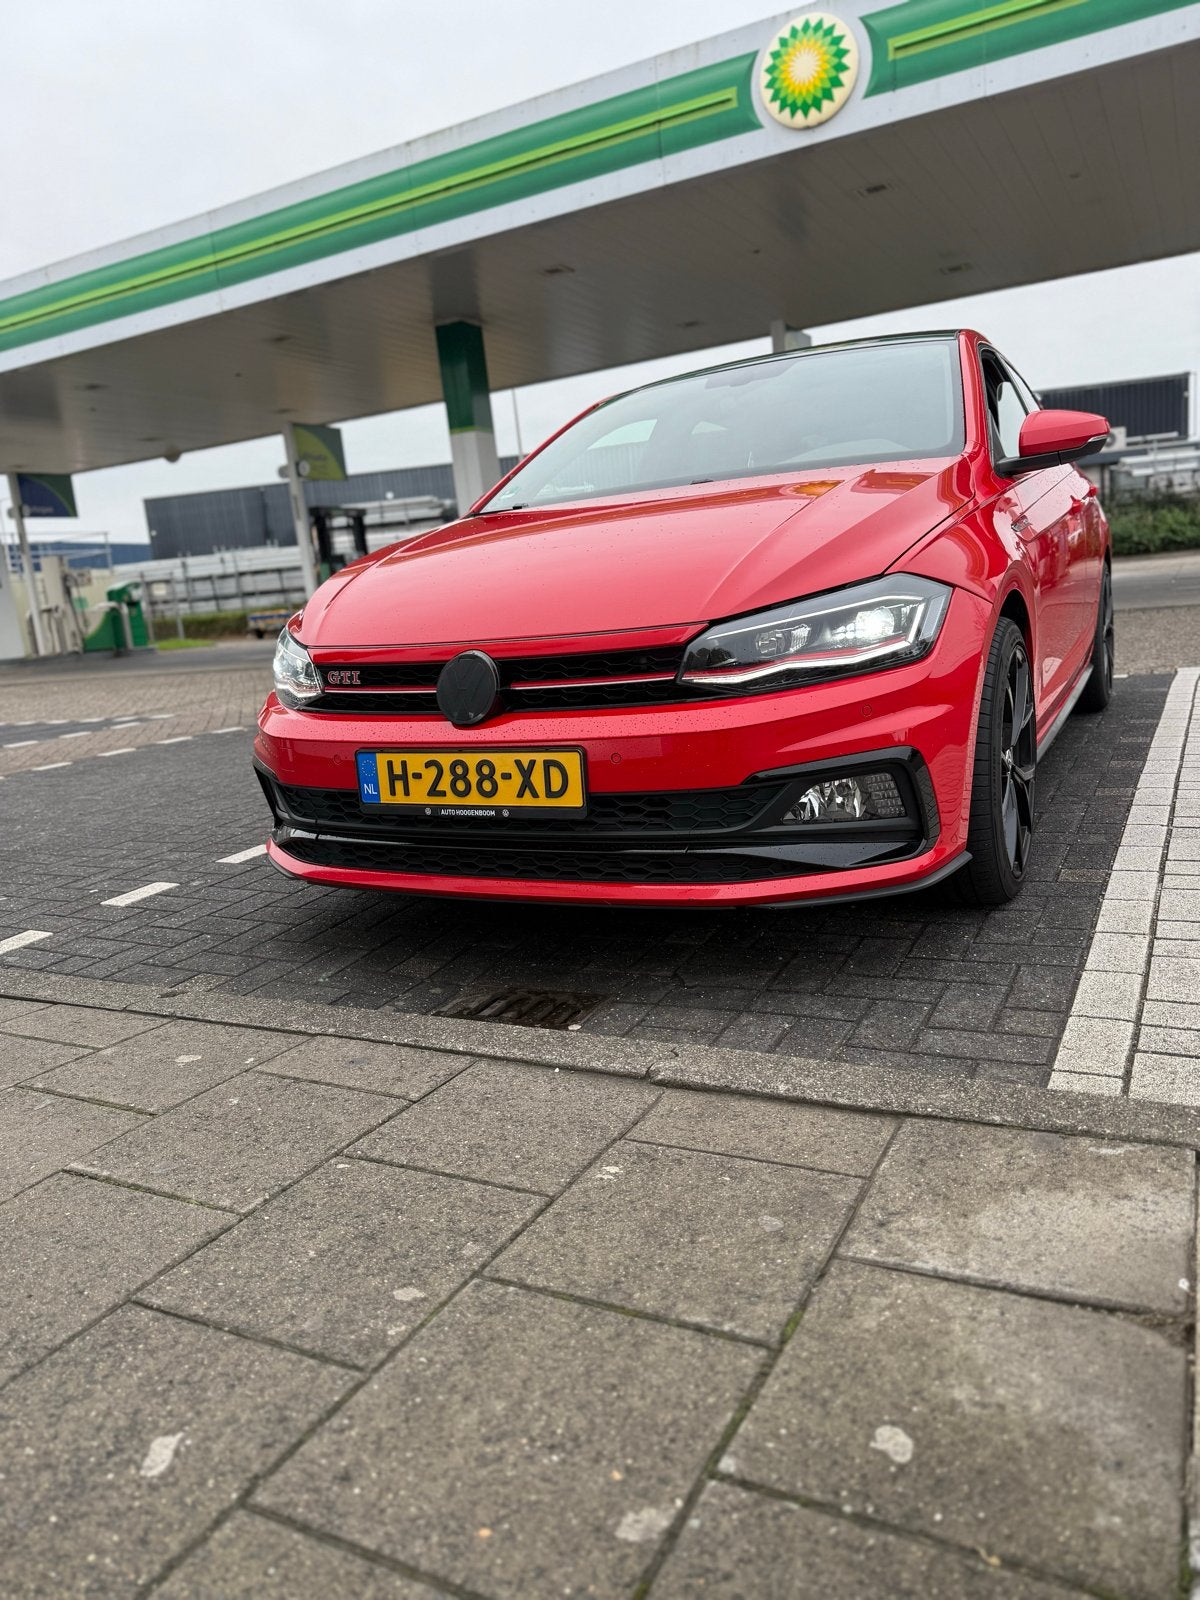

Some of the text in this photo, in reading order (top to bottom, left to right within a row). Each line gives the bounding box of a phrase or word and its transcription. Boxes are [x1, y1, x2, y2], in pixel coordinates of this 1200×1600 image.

[327, 670, 361, 685] GTI
[386, 759, 569, 799] H-288-XD
[363, 783, 378, 795] NL
